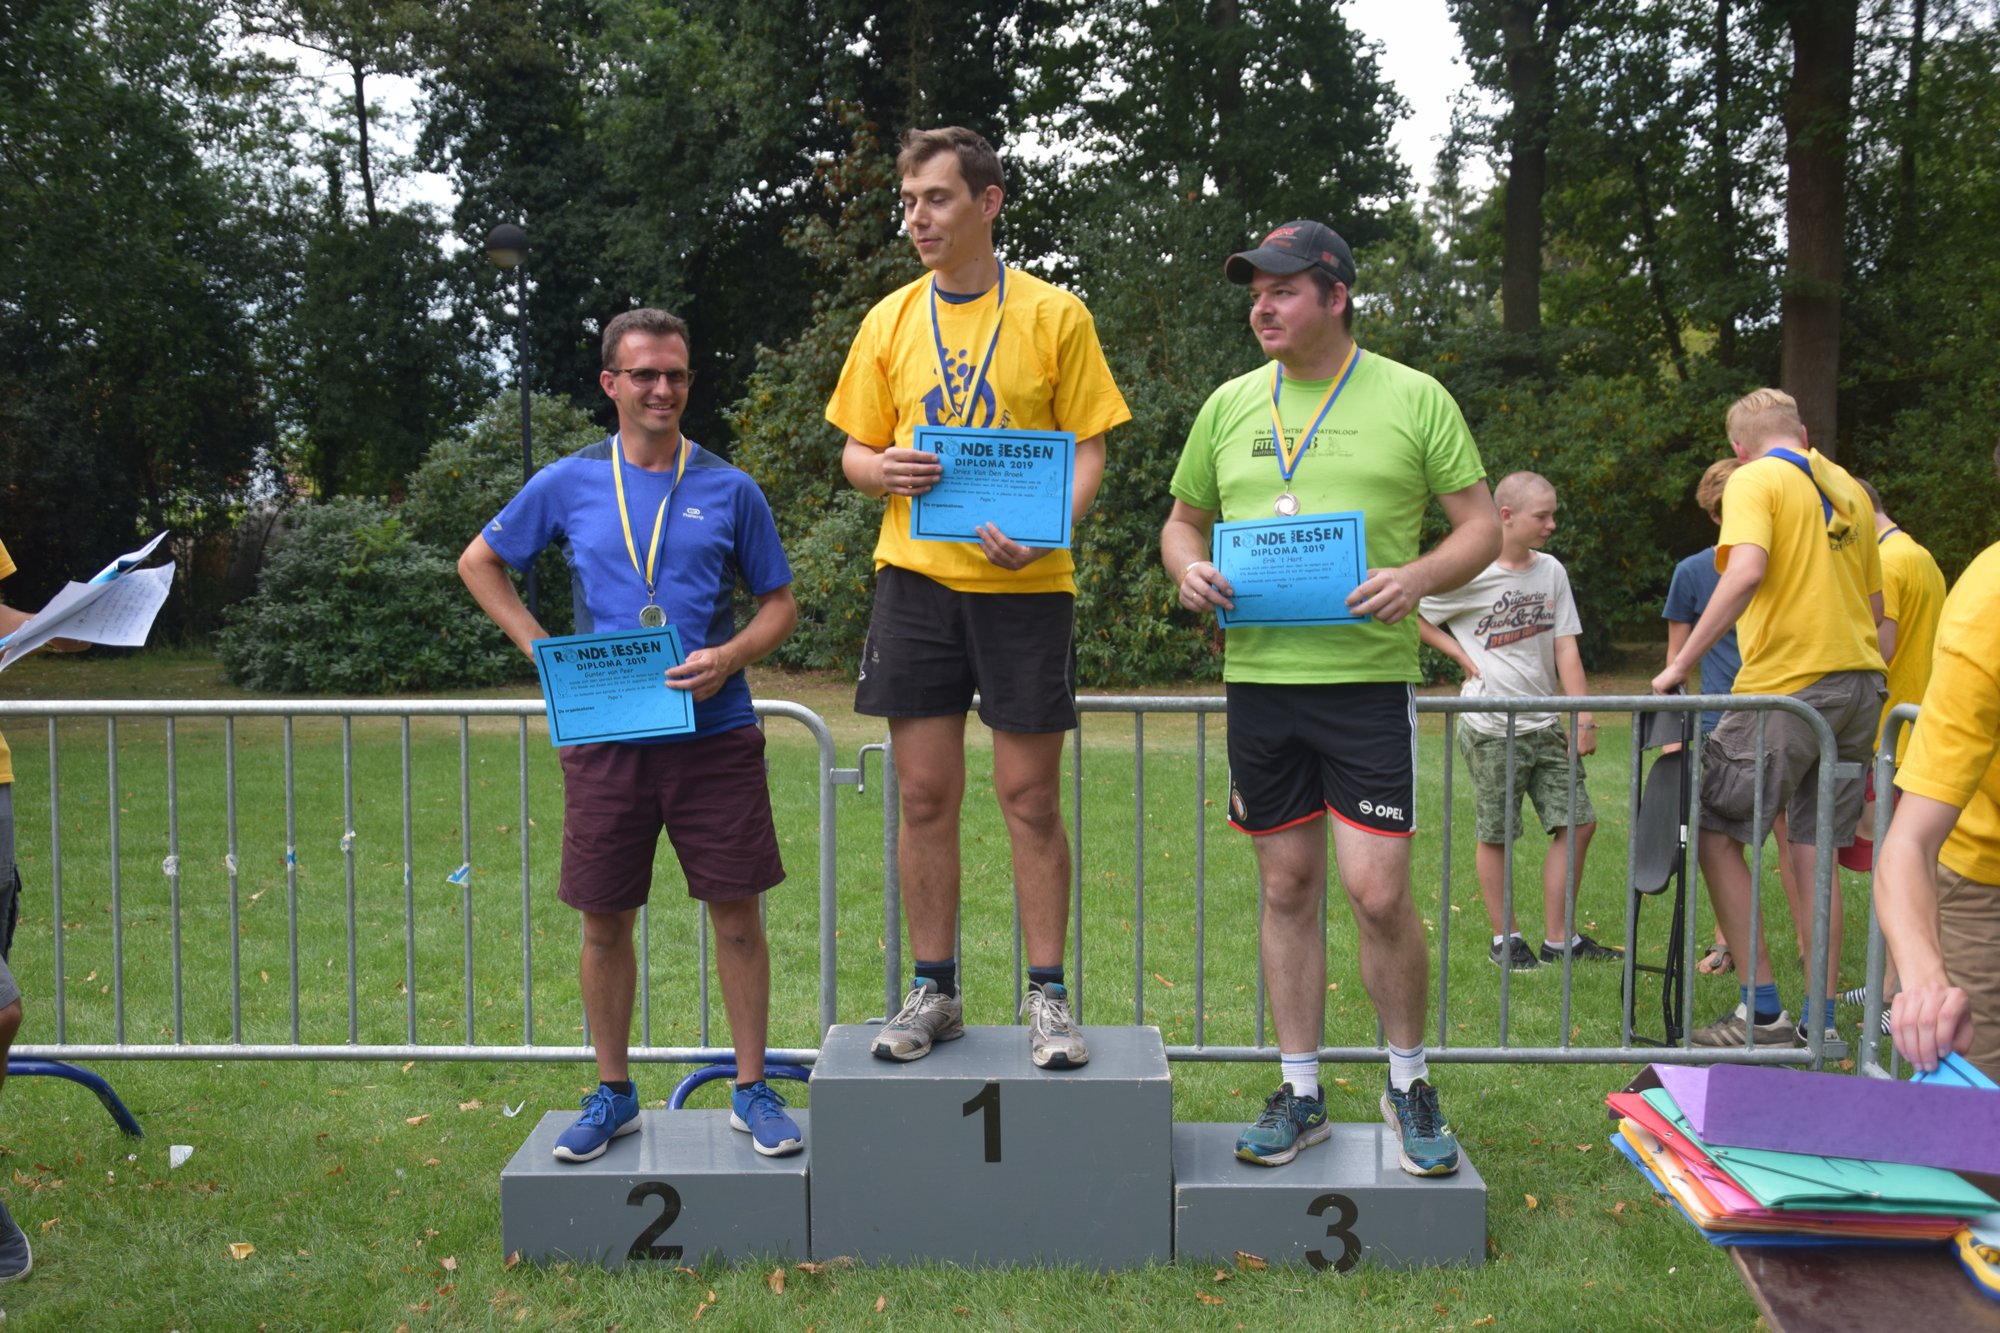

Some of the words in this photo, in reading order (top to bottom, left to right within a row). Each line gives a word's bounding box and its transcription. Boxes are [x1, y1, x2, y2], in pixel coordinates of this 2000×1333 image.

[934, 439, 994, 457] RONDE
[1004, 443, 1054, 460] ESSEN
[955, 458, 1005, 468] DIPLOMA
[1010, 460, 1034, 469] 2019
[1232, 532, 1287, 548] RONDE
[1296, 527, 1344, 543] ESSEN
[1251, 546, 1298, 557] DIPLOMA
[1302, 544, 1326, 554] 2019
[1493, 590, 1548, 615] Superior
[553, 646, 609, 664] RONDE
[615, 640, 662, 657] ESSEN
[576, 658, 623, 671] DIPLOMA
[625, 655, 648, 666] 2019
[1375, 804, 1405, 821] OPEL
[962, 1082, 1002, 1163] 1
[625, 1181, 684, 1260] 2
[1304, 1193, 1362, 1274] 3
